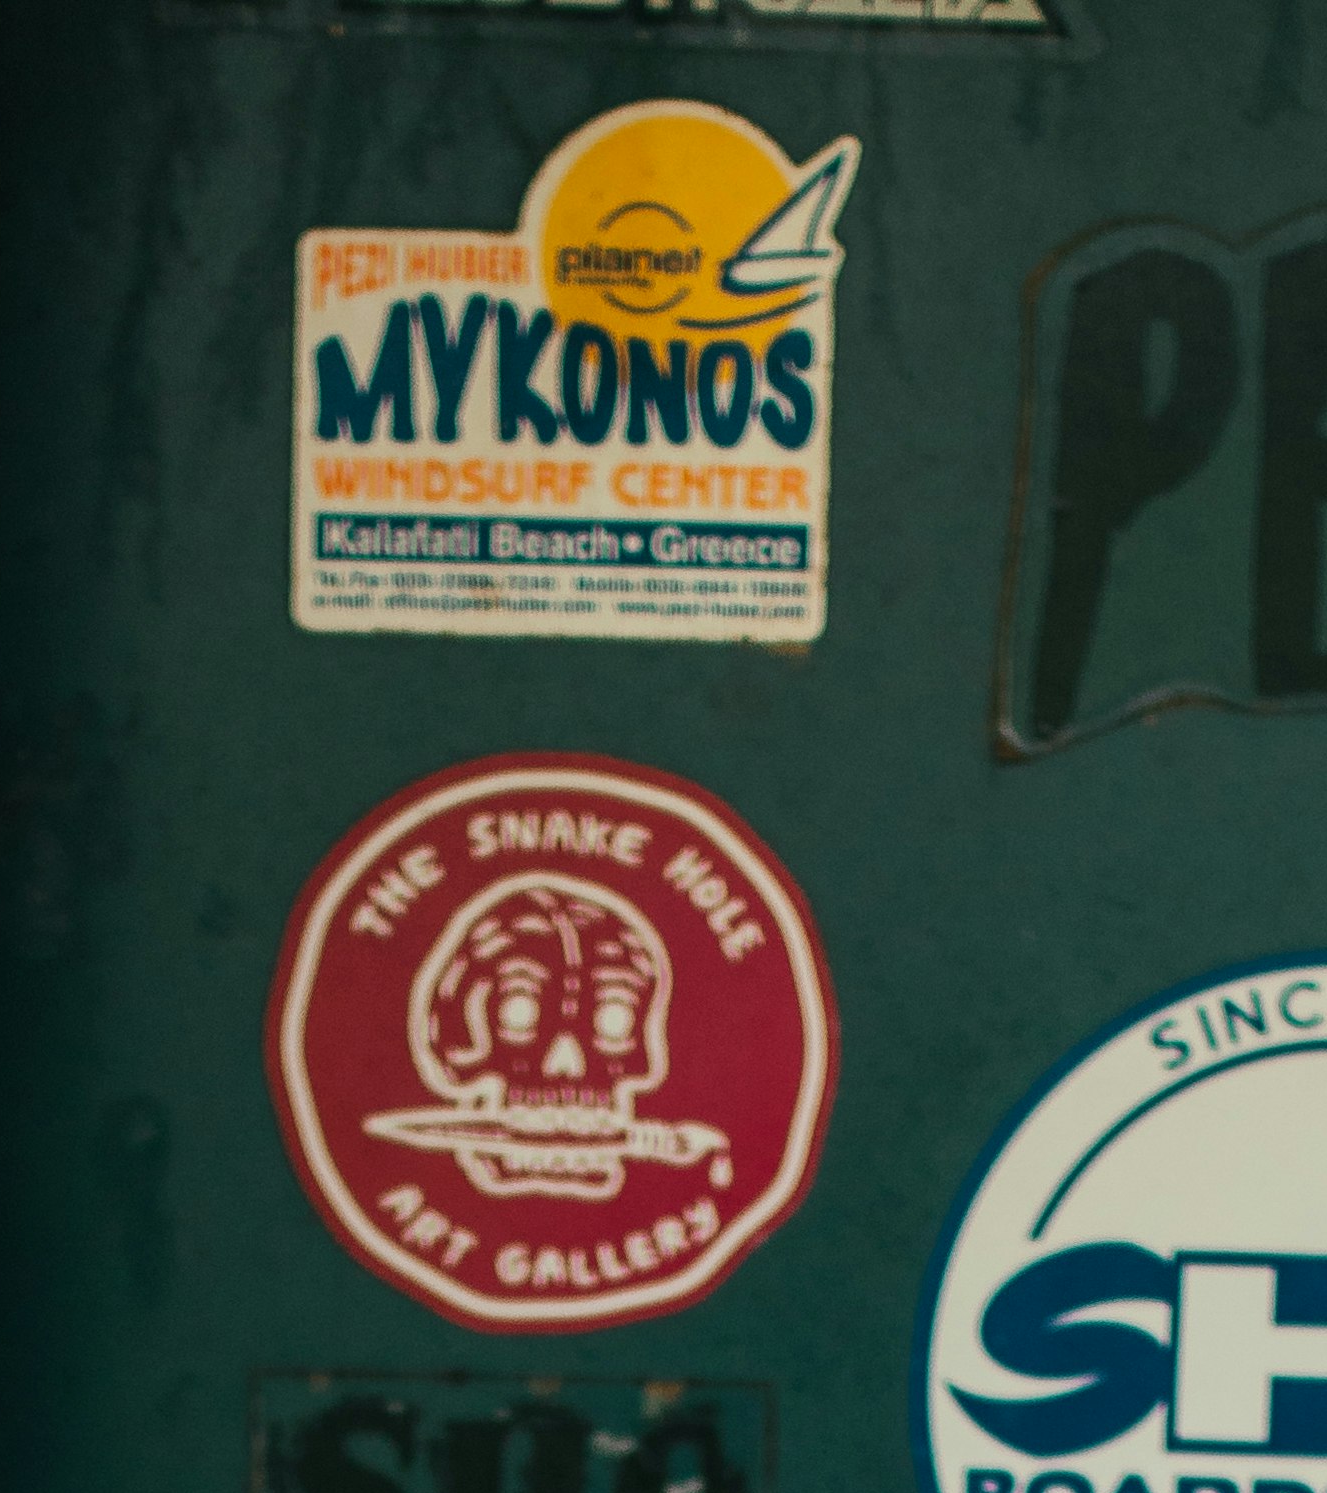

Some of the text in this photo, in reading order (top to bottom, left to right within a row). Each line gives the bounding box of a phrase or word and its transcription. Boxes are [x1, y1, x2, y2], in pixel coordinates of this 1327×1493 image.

[315, 293, 815, 450] MYKONOS
[313, 457, 811, 511] WINDSURF CENTER
[489, 521, 620, 561] Beach
[649, 525, 801, 566] Greece
[349, 808, 766, 961] THE SNAKE HOLE
[379, 1184, 721, 1286] ART GALLERY
